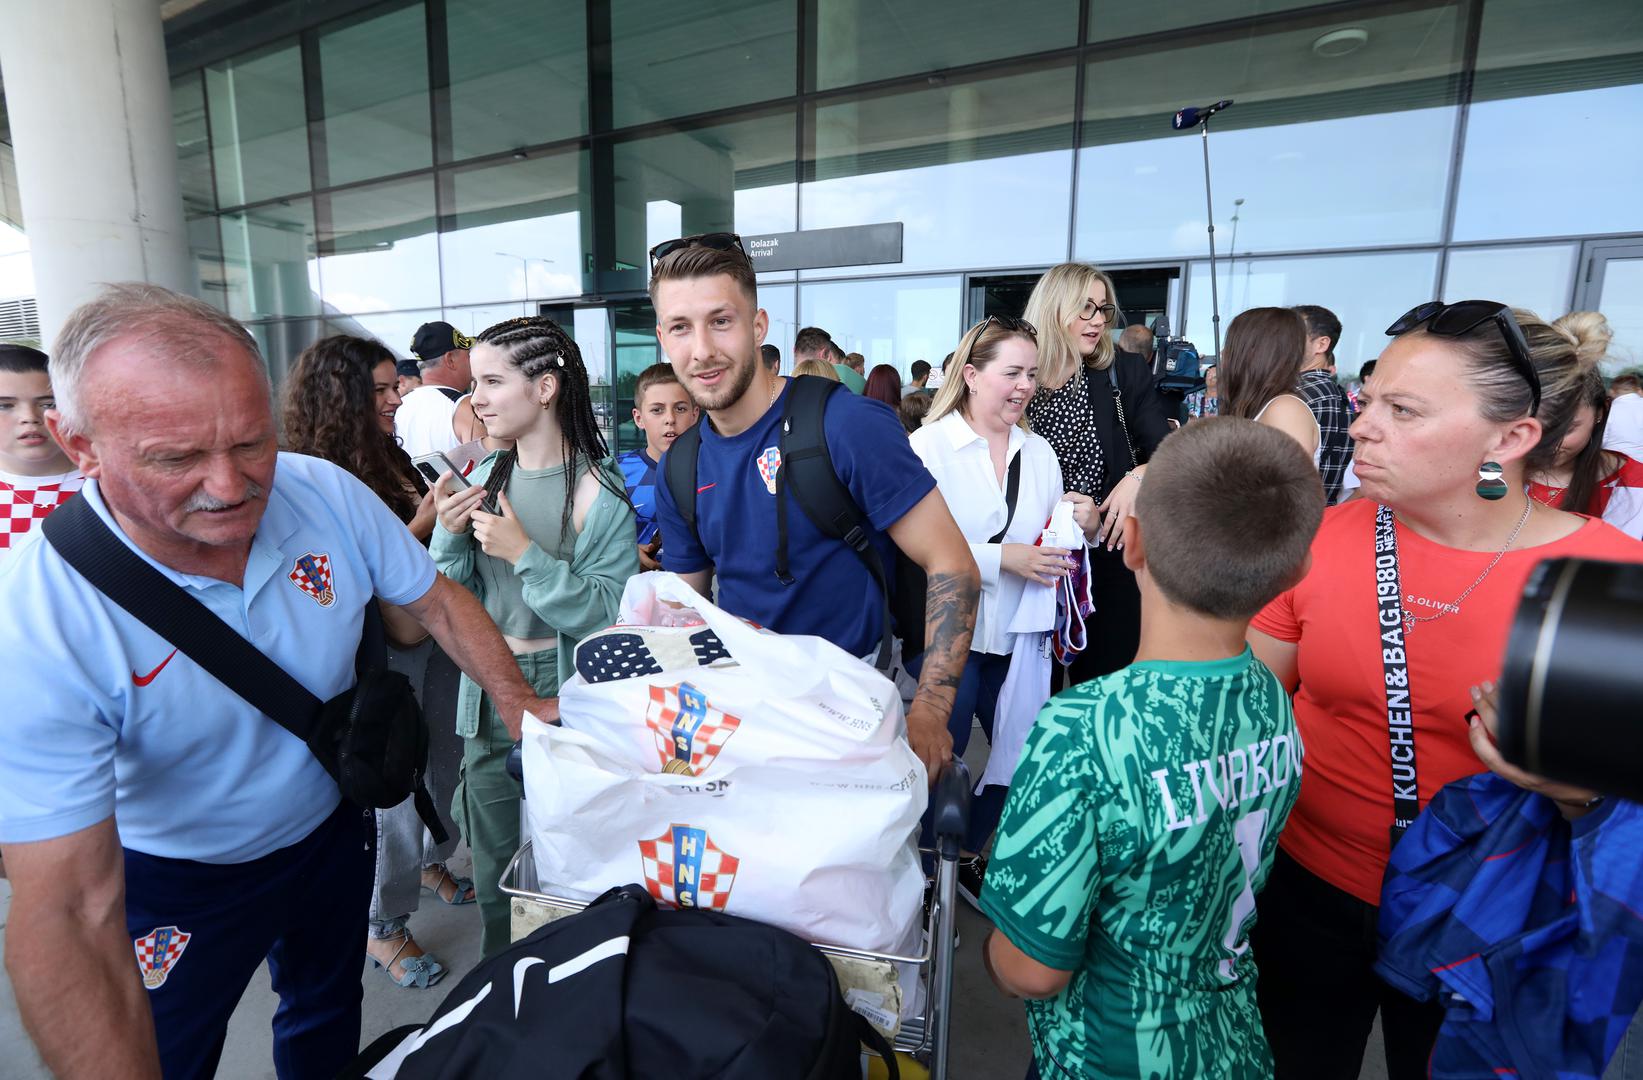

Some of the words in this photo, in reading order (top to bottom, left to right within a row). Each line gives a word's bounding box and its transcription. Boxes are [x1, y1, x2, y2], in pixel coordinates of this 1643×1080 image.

[750, 238, 779, 248] Dolazak
[750, 248, 774, 257] Arrival
[1376, 525, 1385, 552] CITY
[1407, 594, 1460, 615] S.OLIVER
[676, 693, 701, 752] HNS
[1151, 727, 1305, 832] LIVAKOV
[678, 835, 697, 908] HNS
[155, 932, 169, 964] HNS
